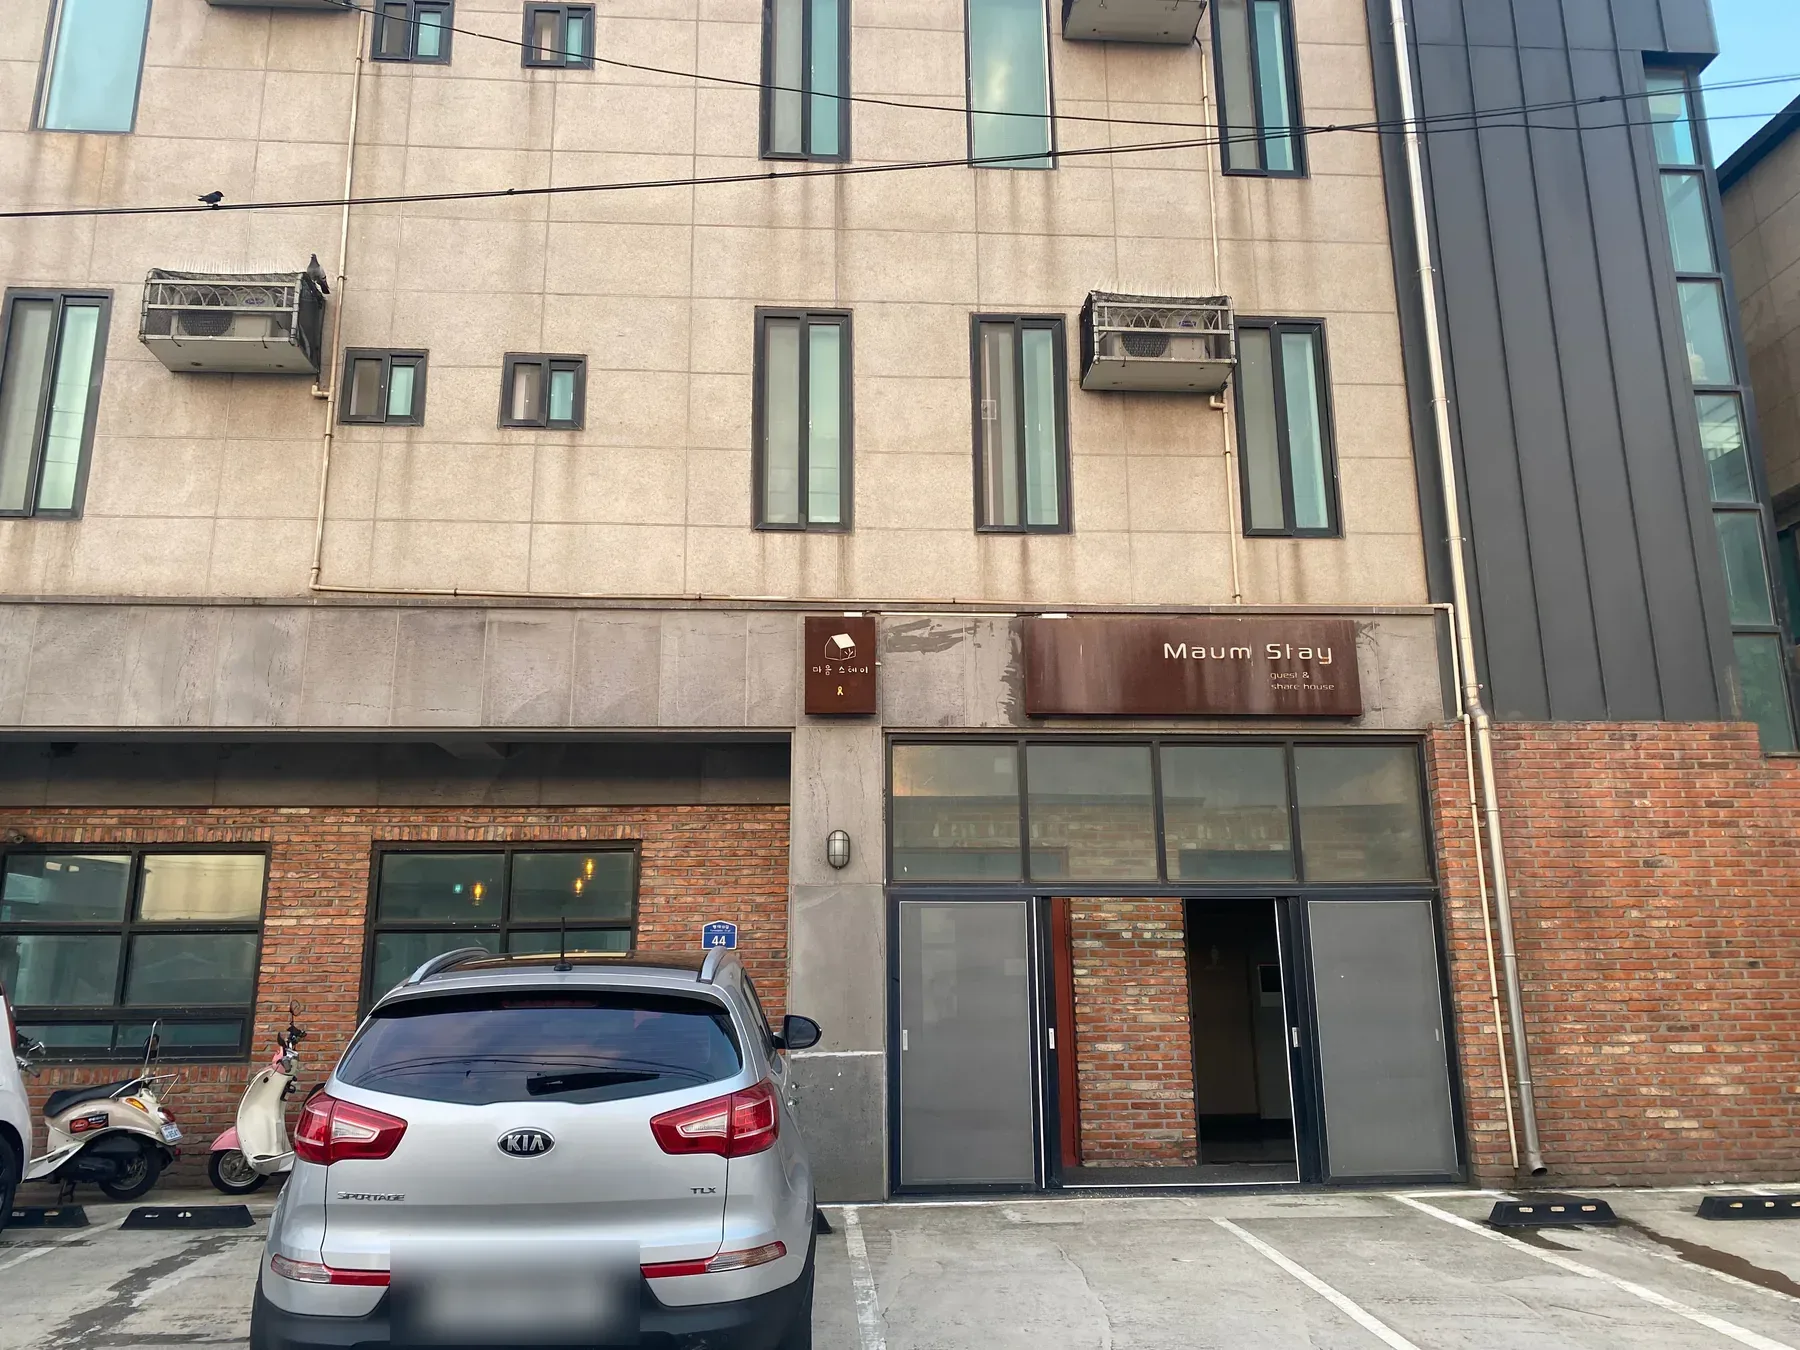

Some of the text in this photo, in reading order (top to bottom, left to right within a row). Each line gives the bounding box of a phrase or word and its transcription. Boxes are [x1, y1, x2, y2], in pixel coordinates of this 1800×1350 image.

[1163, 642, 1332, 665] Maum Stay
[812, 664, 869, 676] 마음 스테이
[1269, 671, 1311, 680] guest &
[1270, 683, 1335, 691] share house
[711, 935, 727, 946] 44
[506, 1134, 545, 1151] KIA
[690, 1186, 717, 1195] TLX
[337, 1191, 405, 1202] SPORTAGE
